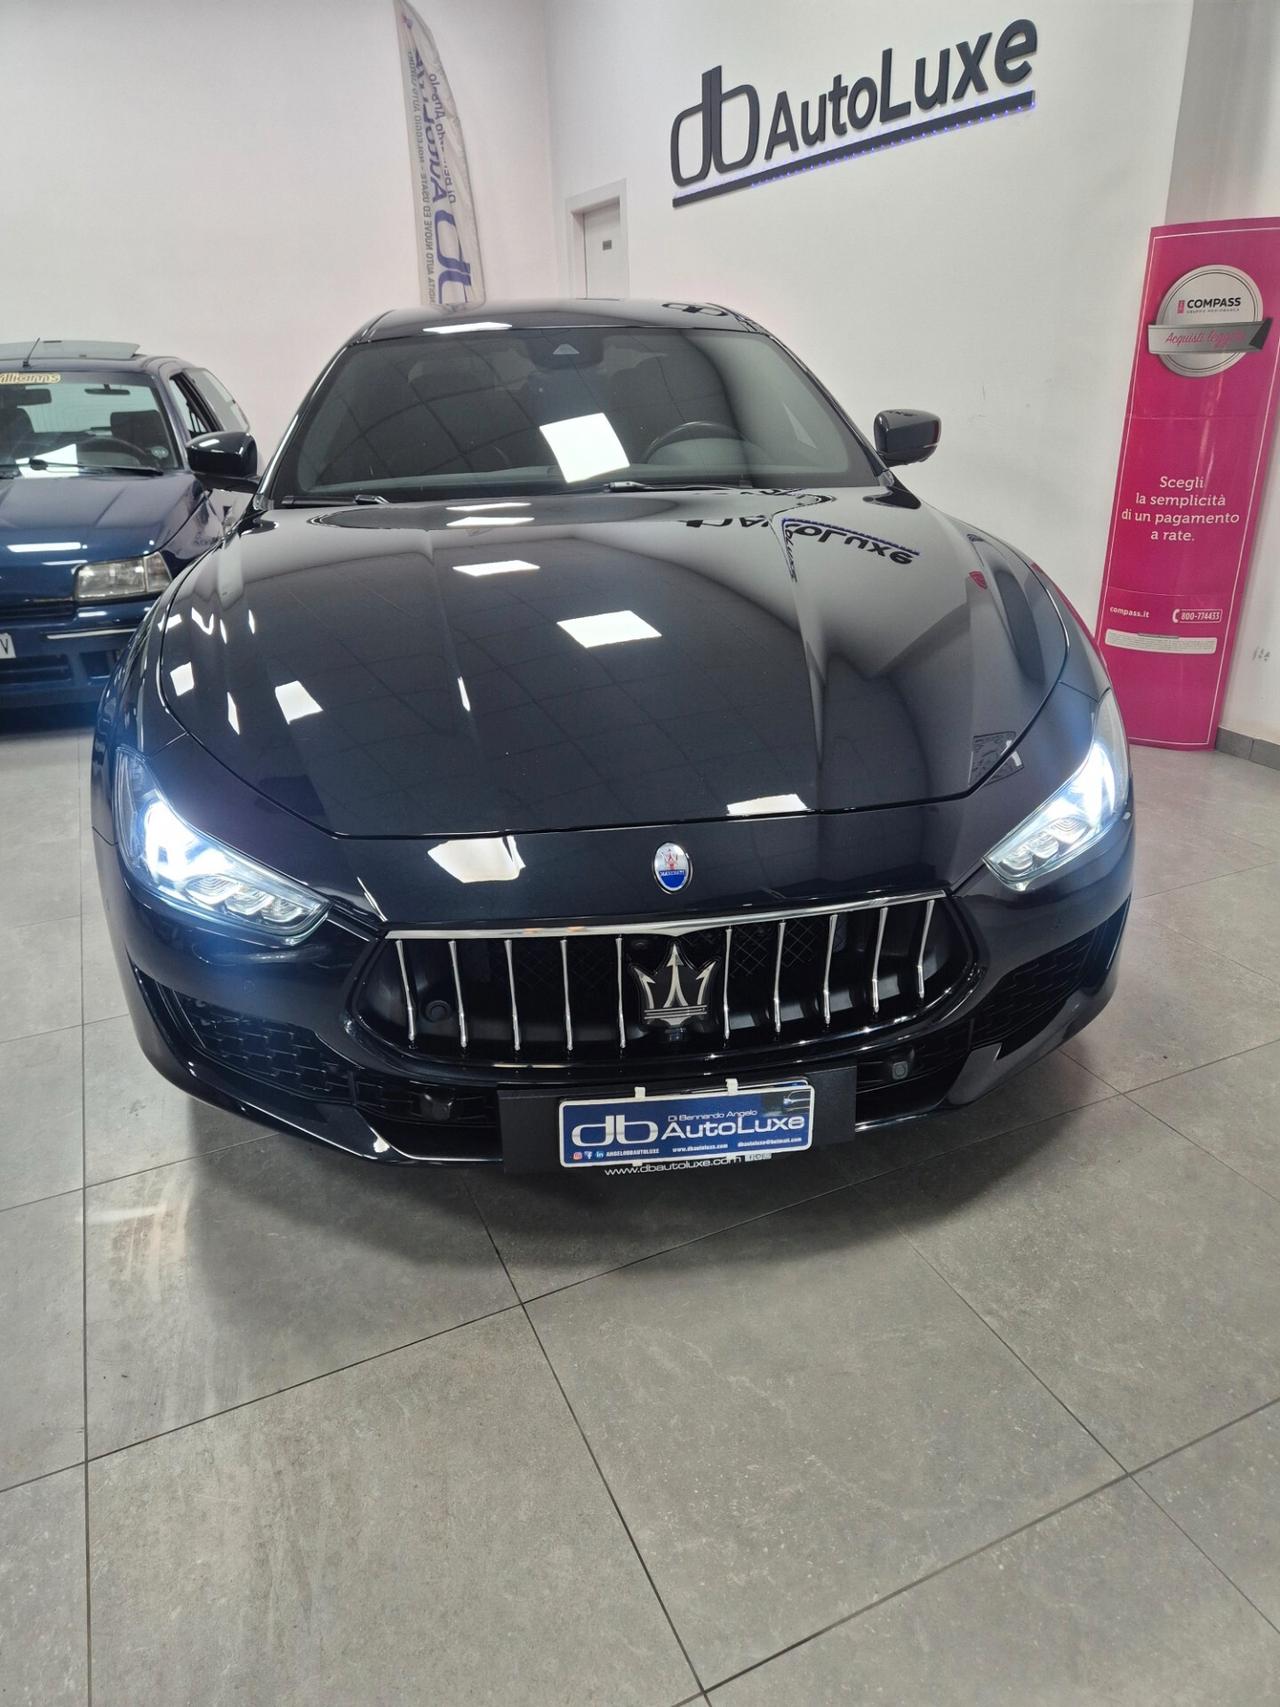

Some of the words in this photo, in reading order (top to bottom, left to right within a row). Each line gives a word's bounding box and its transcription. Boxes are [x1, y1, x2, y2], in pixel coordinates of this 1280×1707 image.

[764, 18, 1038, 161] AutoLuxe
[1186, 297, 1241, 309] COMPASS
[1159, 475, 1205, 491] Scegli
[1135, 492, 1146, 505] la
[1149, 493, 1226, 509] semplicità
[1121, 508, 1132, 521] di
[1134, 511, 1151, 522] un
[1154, 512, 1241, 525] pagamento
[1150, 530, 1159, 541] a
[1162, 530, 1196, 542] rate.
[660, 1115, 806, 1141] AutoLuxe
[604, 1157, 742, 1176] www.dbautoluxe.com
